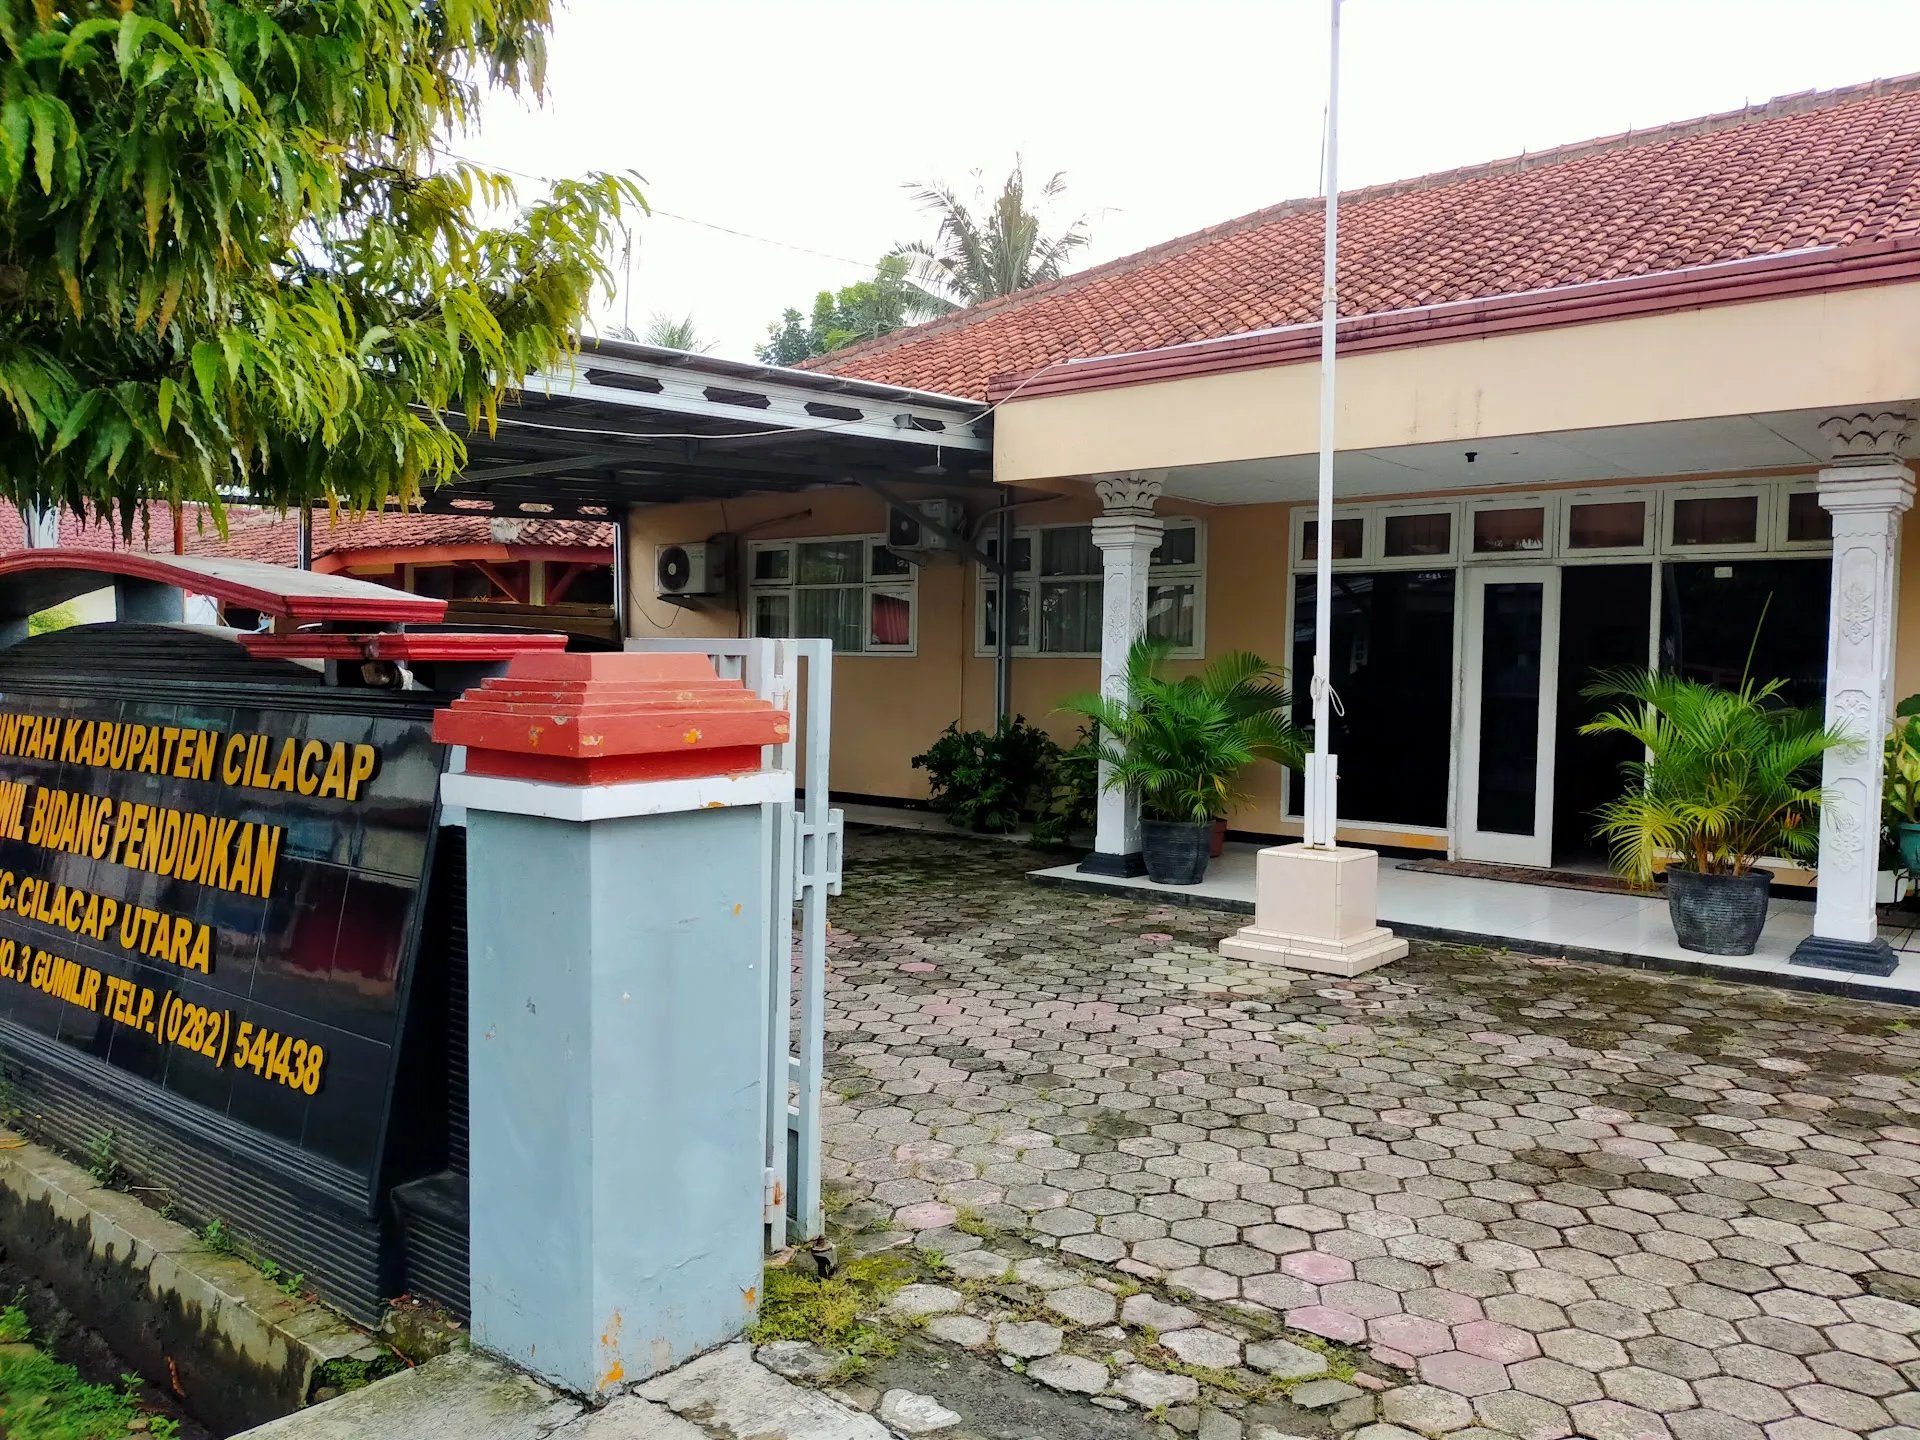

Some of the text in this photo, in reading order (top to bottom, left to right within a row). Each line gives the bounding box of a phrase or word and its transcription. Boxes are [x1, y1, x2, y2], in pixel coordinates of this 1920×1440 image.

[0, 713, 375, 801] INTAH KABUPATEN CILACAP
[27, 786, 113, 860] BIDANG
[110, 801, 281, 899] PENDIDIKAN
[0, 868, 211, 974] C. CILACAP UTARA
[16, 945, 31, 983] 3
[30, 950, 102, 1011] GUMILIR
[103, 975, 155, 1034] TELP.
[157, 989, 230, 1067] (0282)
[233, 1020, 325, 1096] 541438
